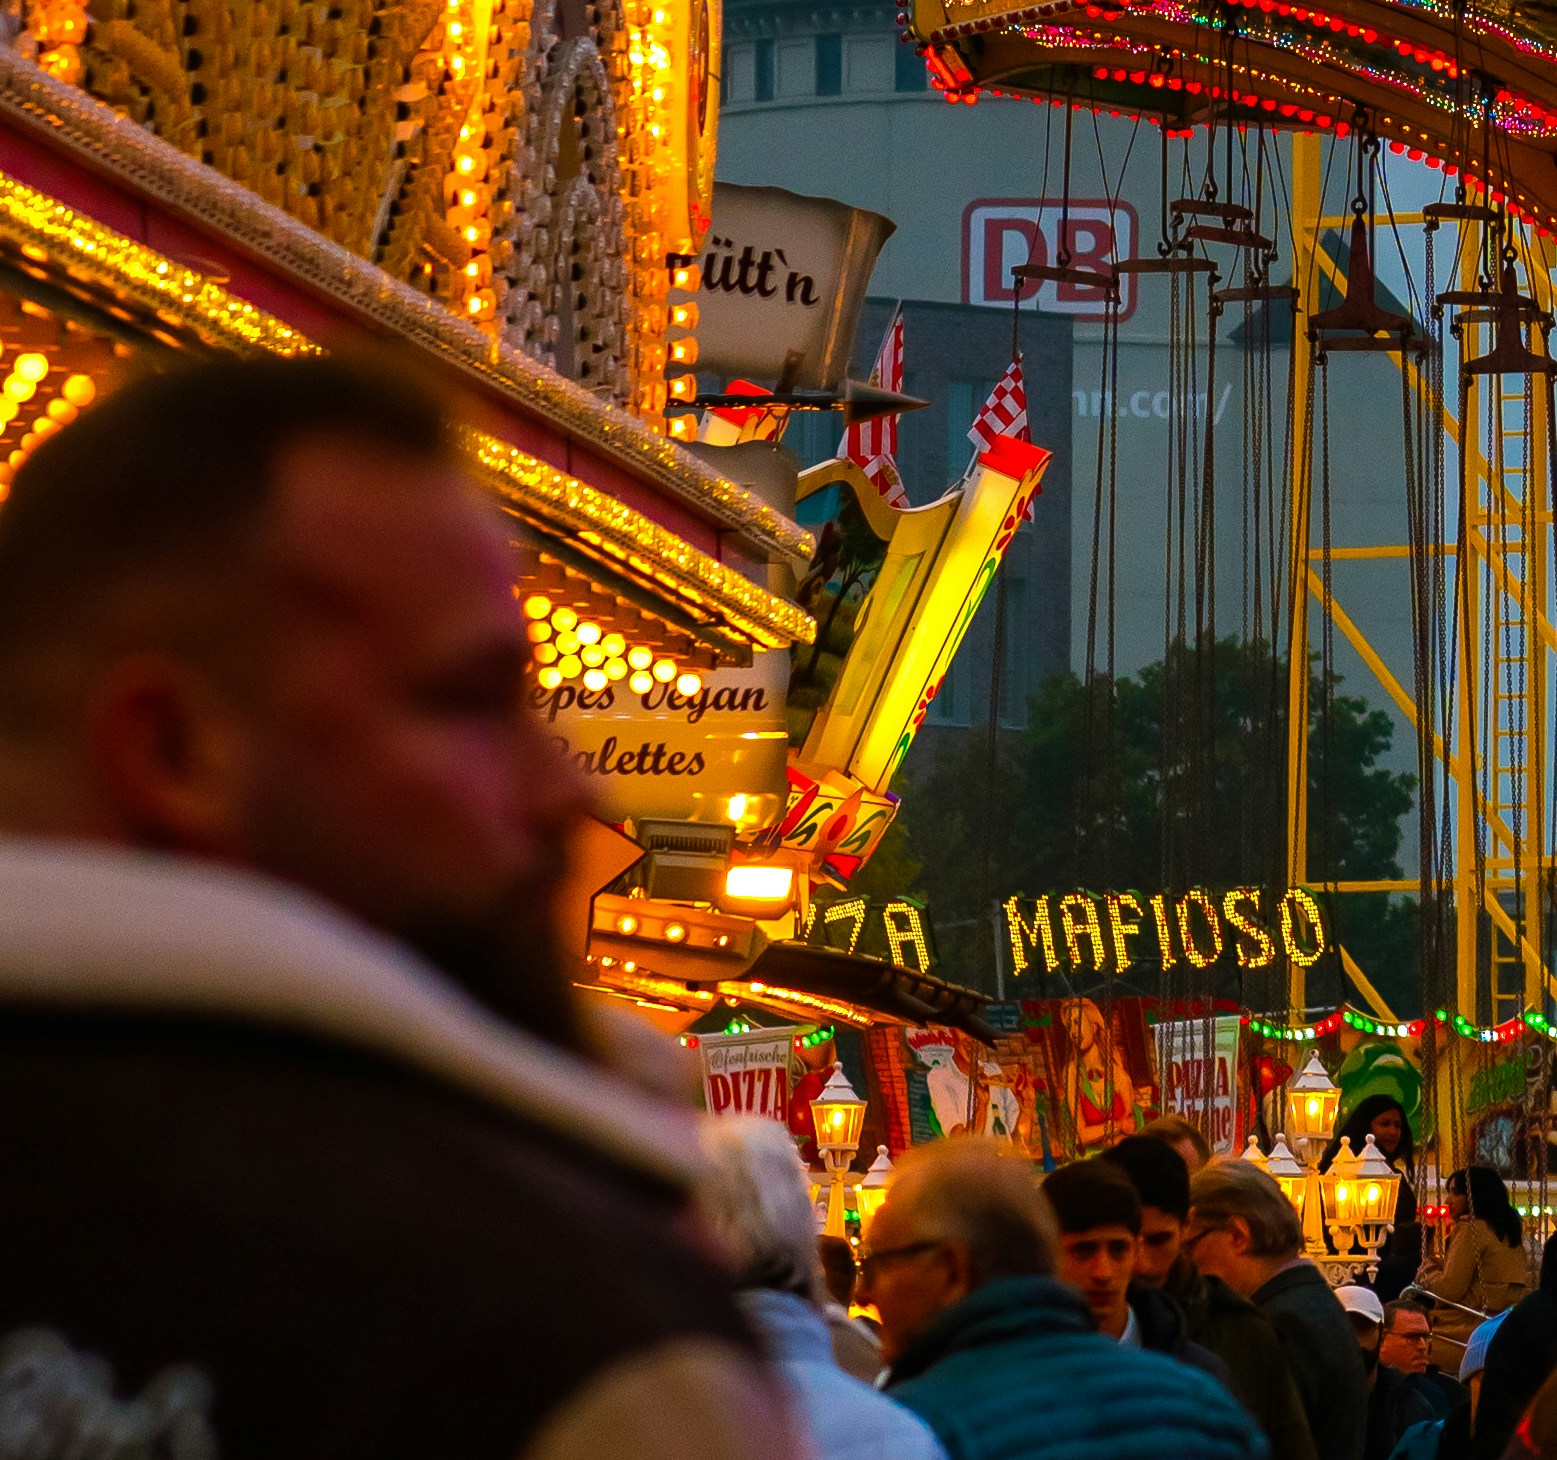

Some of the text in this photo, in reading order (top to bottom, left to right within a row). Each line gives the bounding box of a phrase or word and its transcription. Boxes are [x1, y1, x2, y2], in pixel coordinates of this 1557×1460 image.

[983, 218, 1118, 302] DB
[640, 681, 768, 723] Vegan
[1003, 886, 1326, 976] MAFIOSO
[708, 1067, 787, 1121] PIZZA
